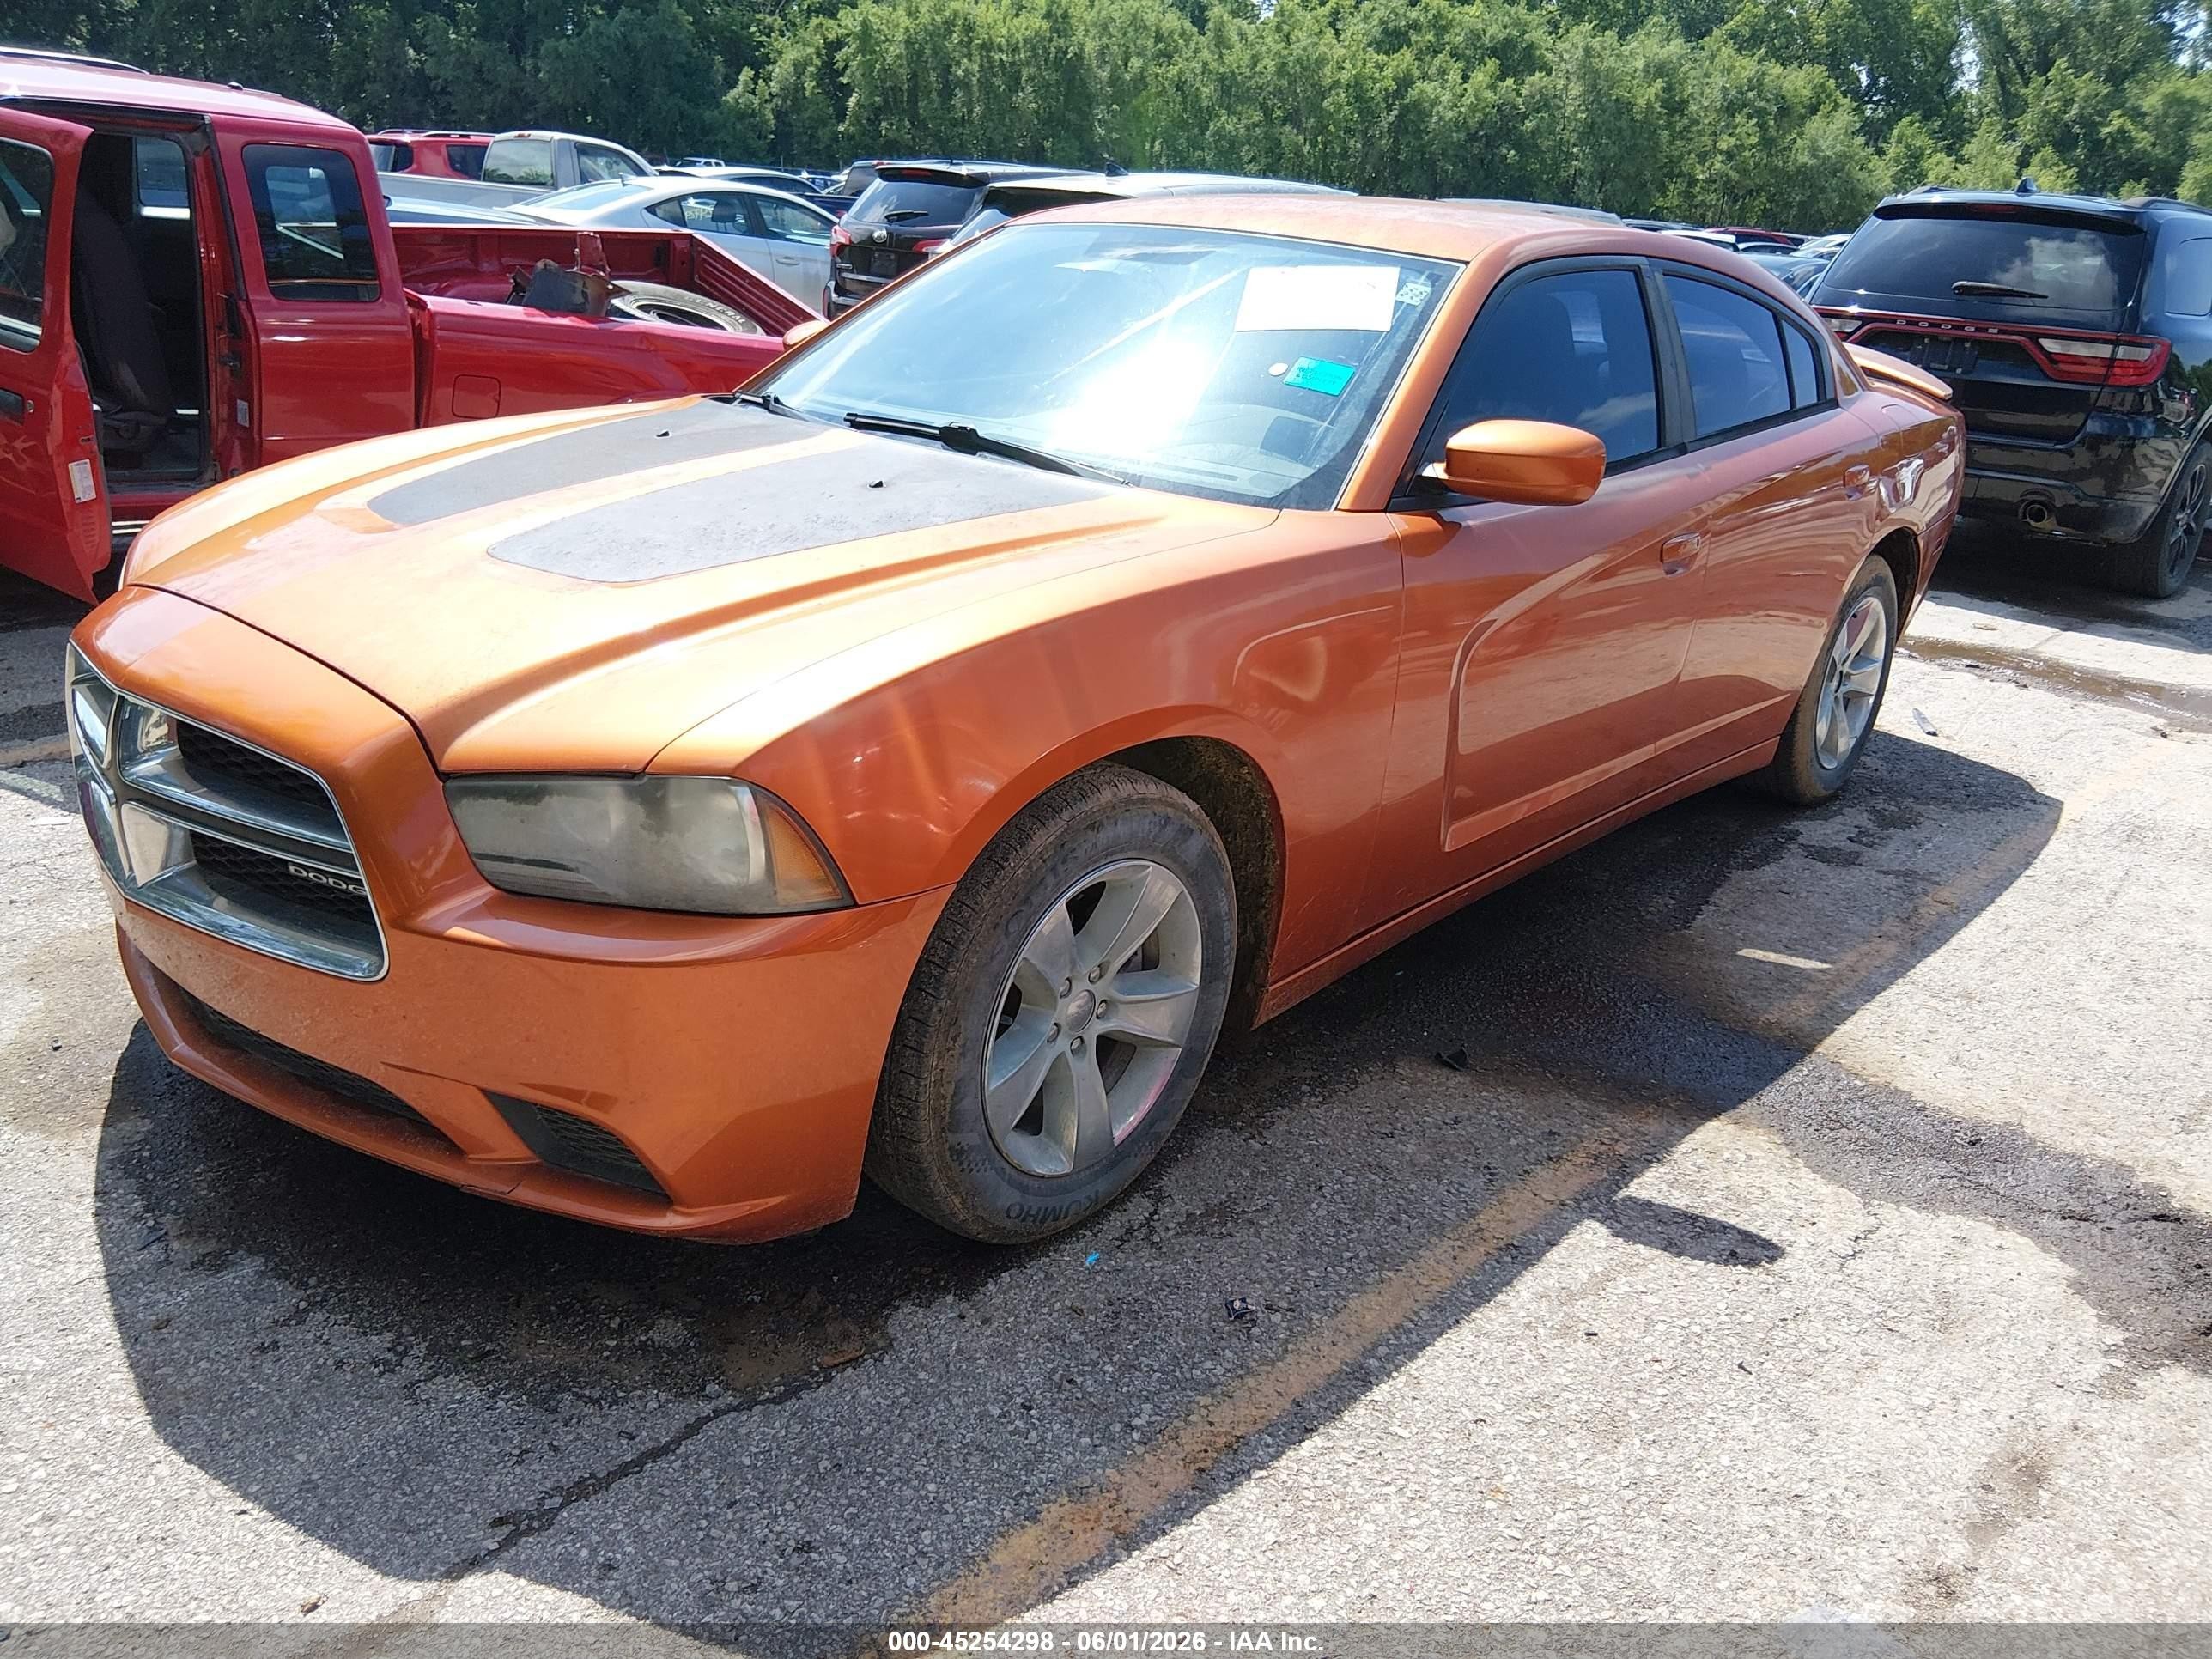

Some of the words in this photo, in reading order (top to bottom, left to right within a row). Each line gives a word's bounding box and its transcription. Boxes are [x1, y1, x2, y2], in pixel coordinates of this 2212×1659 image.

[1895, 319, 1999, 334] DODGE
[288, 863, 368, 895] DODG
[1005, 1189, 1100, 1224] KUMHO
